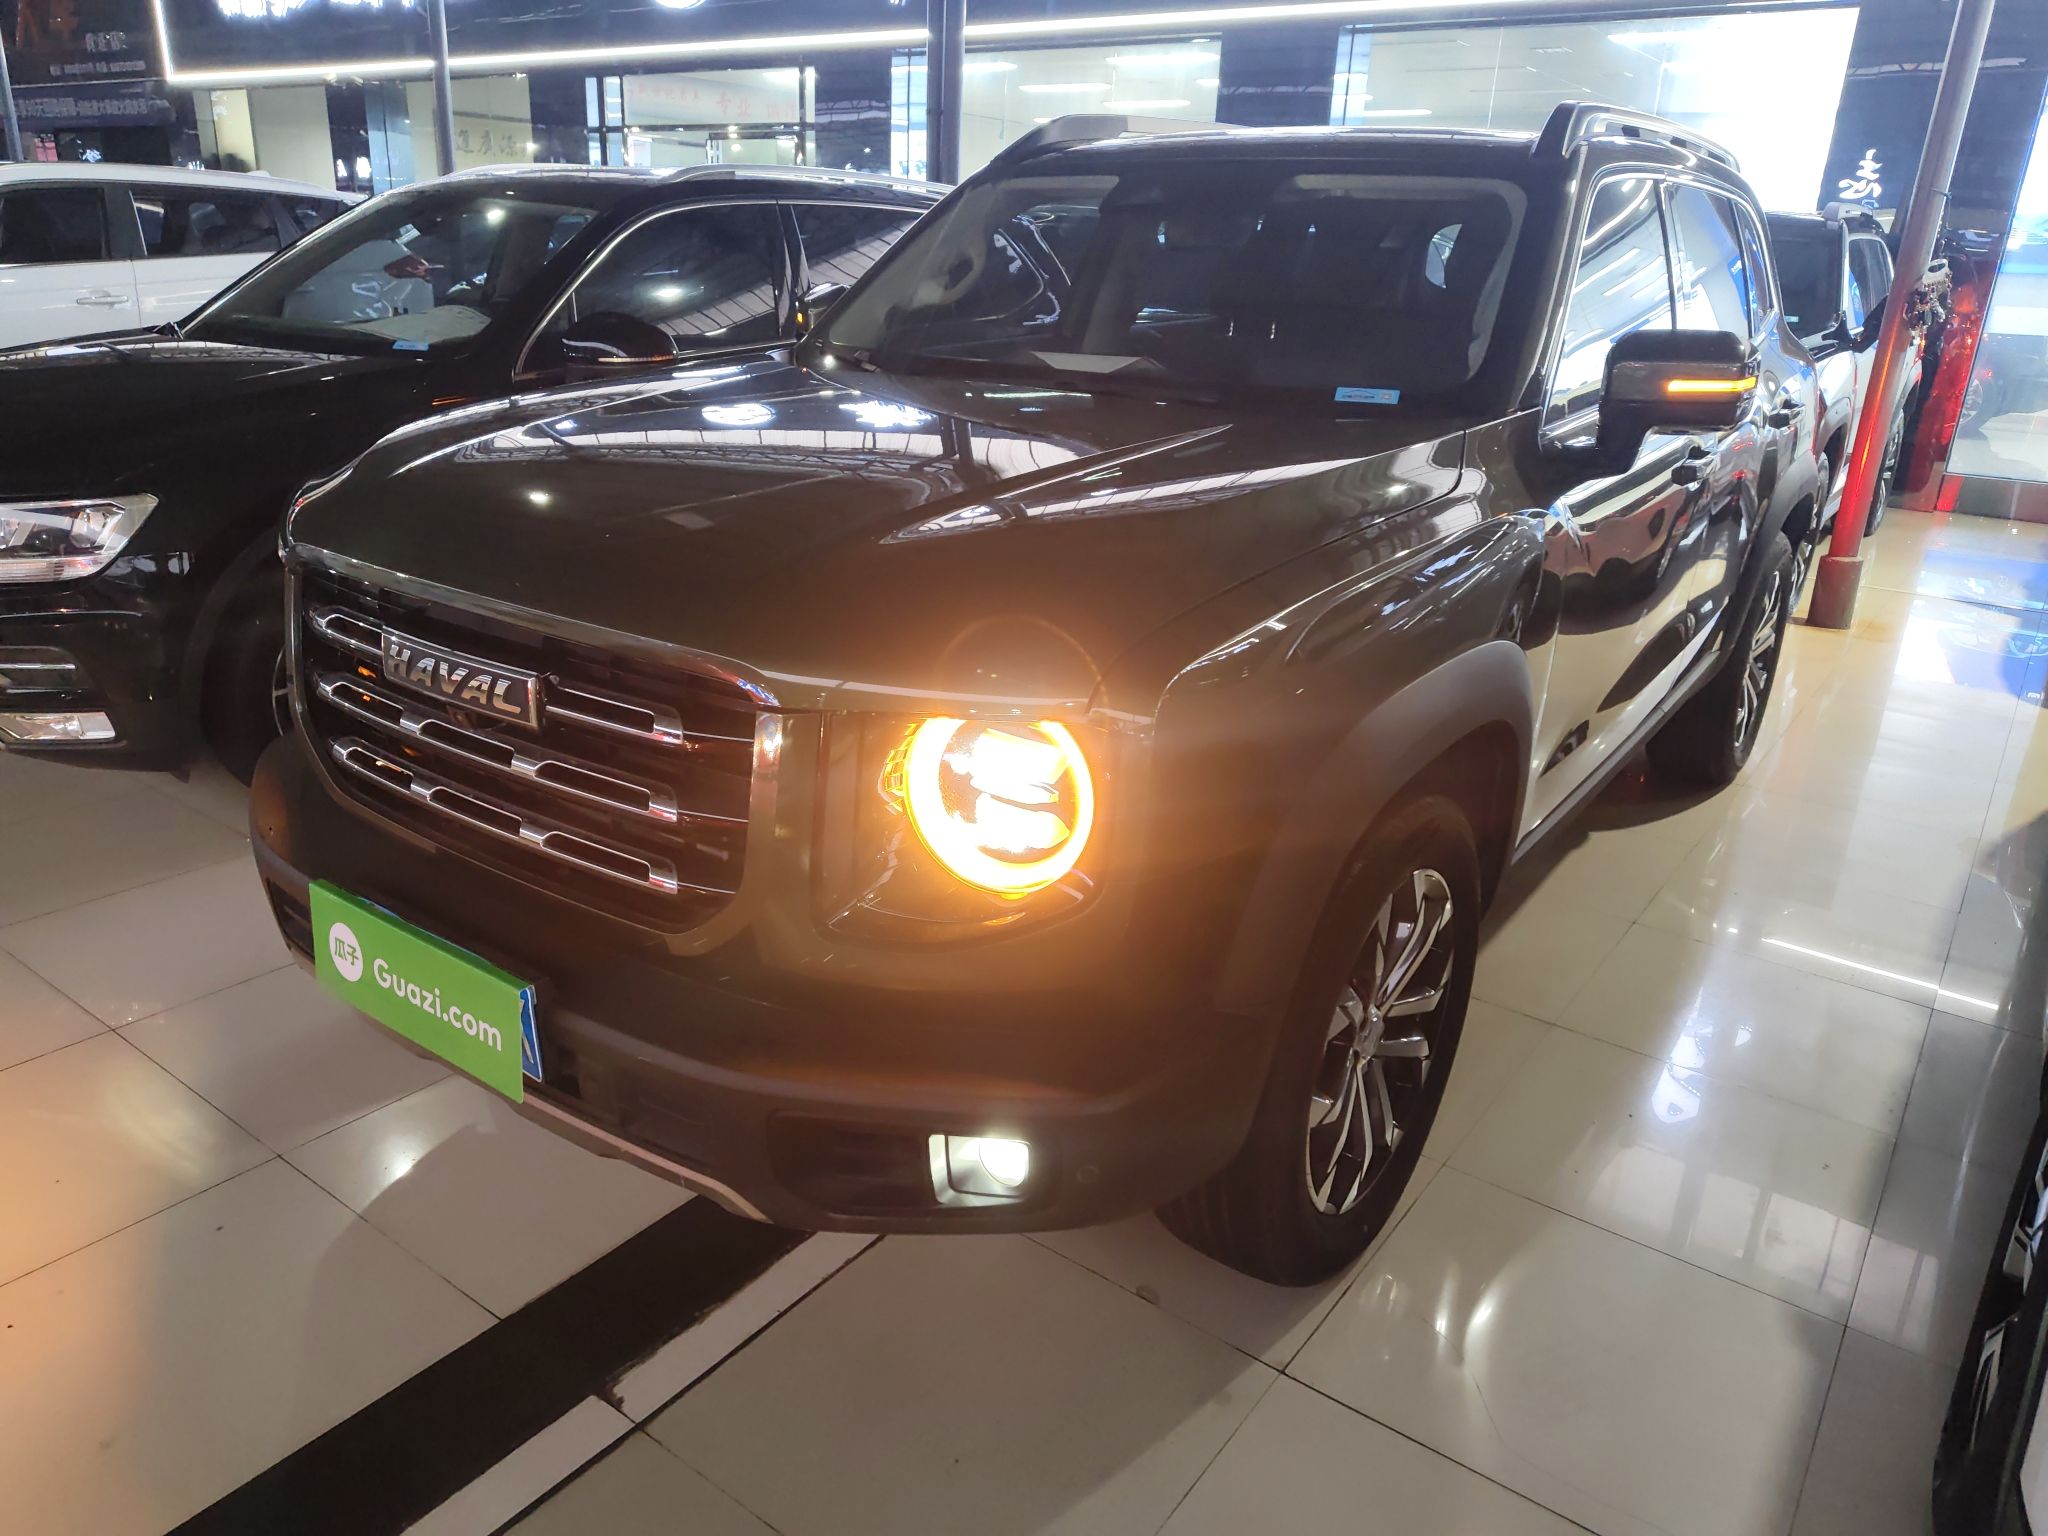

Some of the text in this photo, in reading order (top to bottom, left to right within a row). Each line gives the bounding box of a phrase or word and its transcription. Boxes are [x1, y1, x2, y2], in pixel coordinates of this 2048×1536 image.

[388, 644, 522, 714] HAVAL
[334, 936, 359, 966] 瓜子
[373, 958, 502, 1051] Guazi.com
